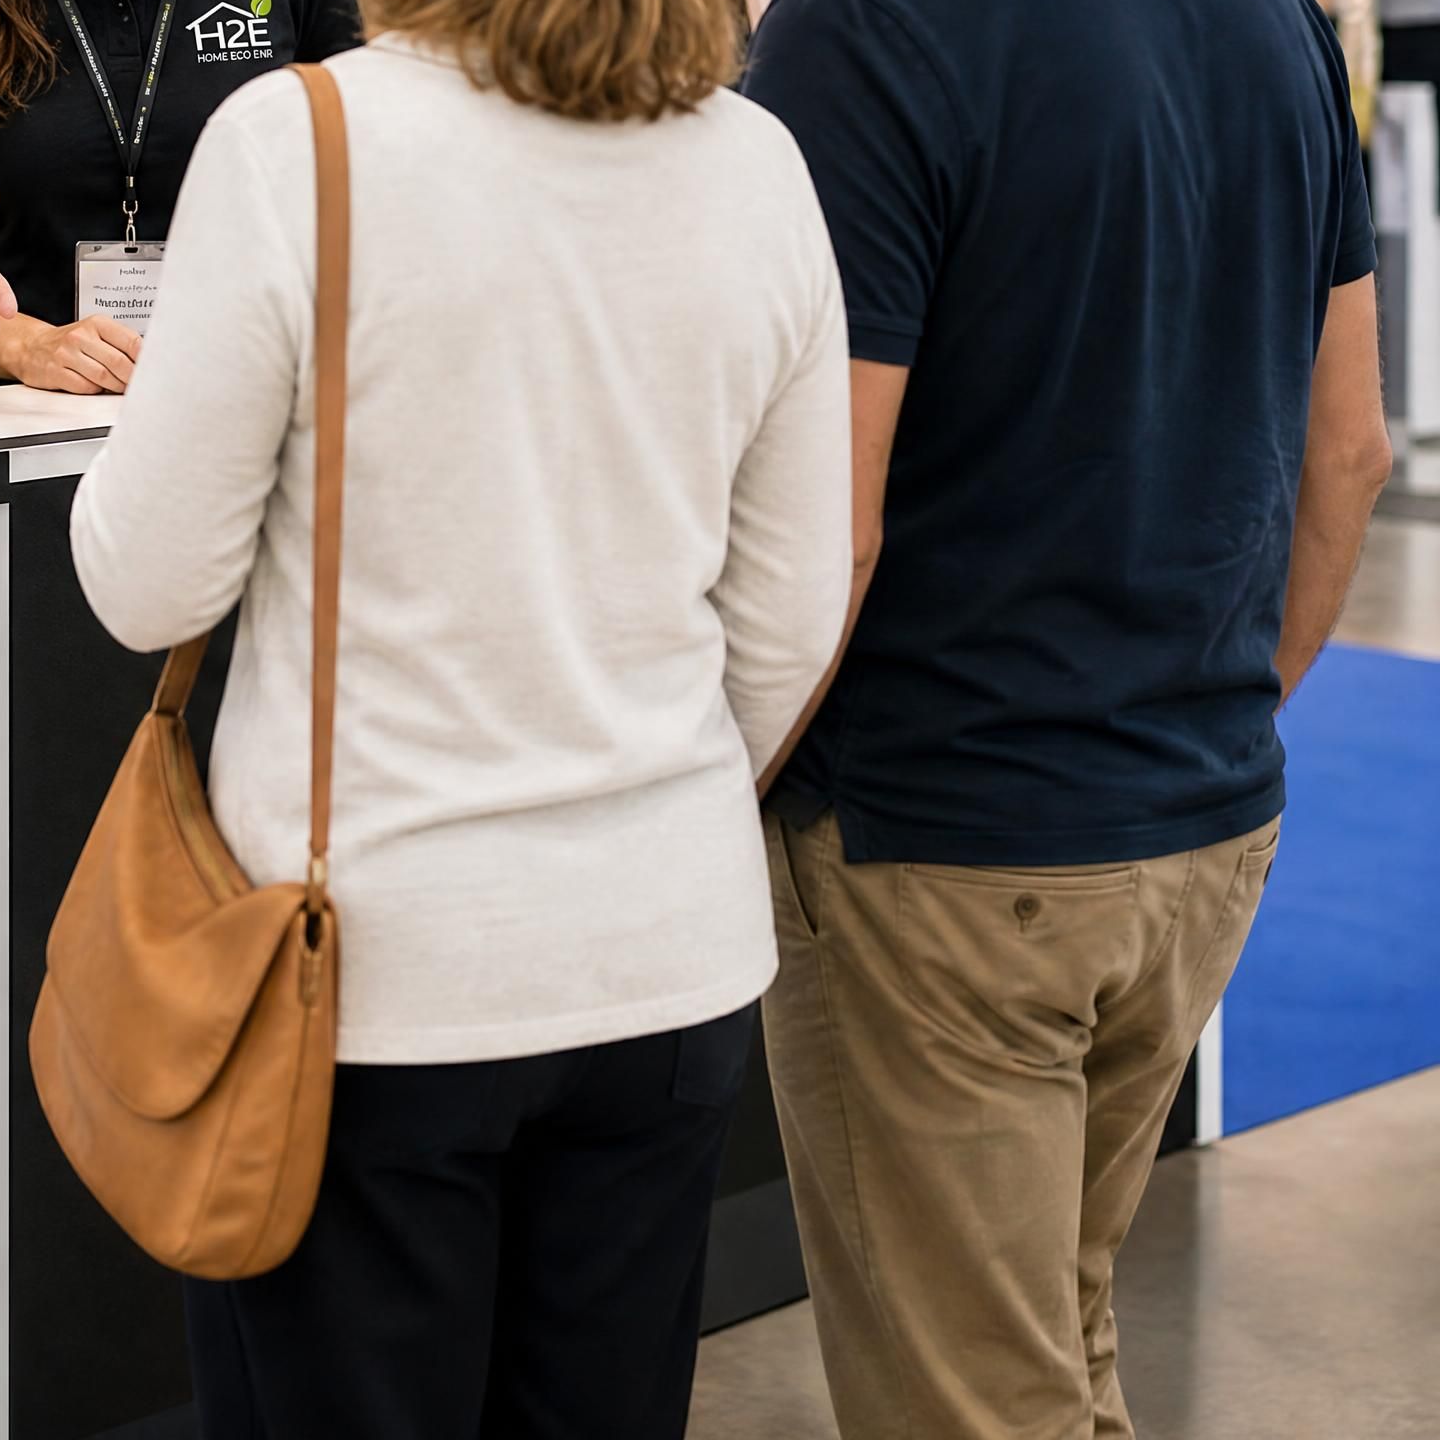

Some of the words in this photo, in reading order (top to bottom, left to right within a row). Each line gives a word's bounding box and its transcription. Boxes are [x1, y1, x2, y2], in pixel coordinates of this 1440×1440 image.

[194, 18, 272, 51] H2E
[197, 51, 229, 64] HOME
[230, 49, 252, 61] ECO
[253, 48, 274, 59] ENR
